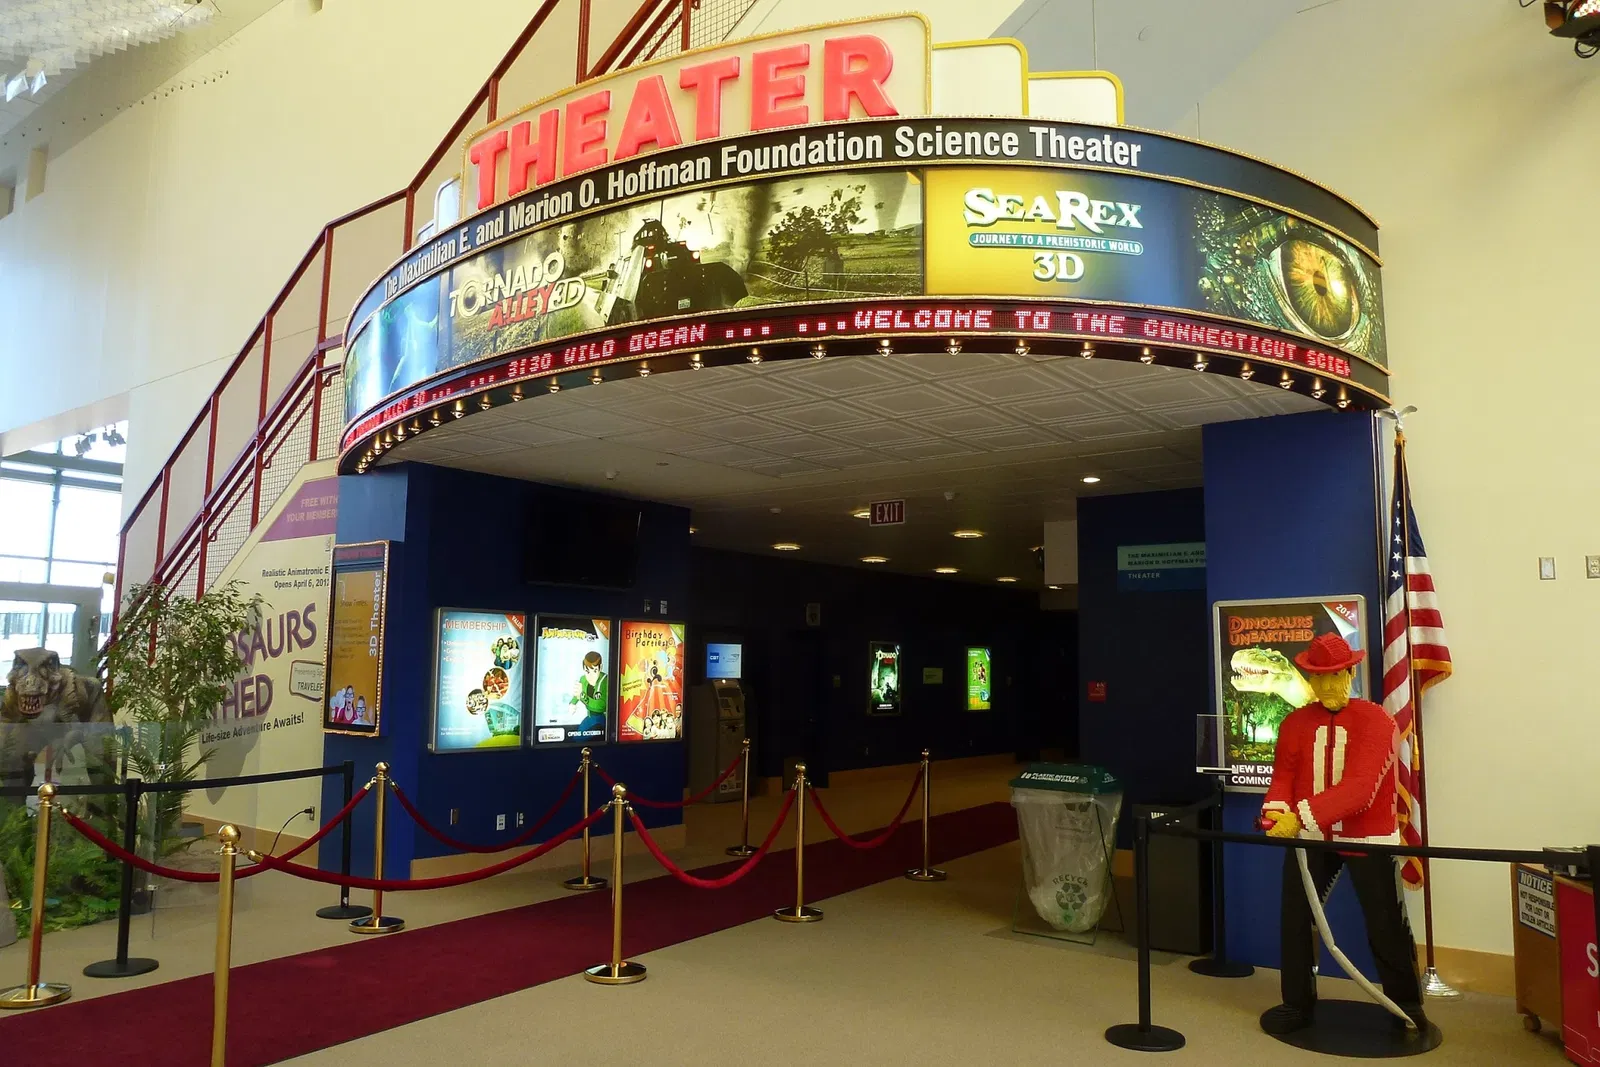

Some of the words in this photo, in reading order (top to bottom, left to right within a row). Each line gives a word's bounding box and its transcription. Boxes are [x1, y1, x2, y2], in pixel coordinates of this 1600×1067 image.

[470, 34, 899, 210] THEATER
[384, 275, 399, 300] The
[400, 238, 457, 290] Maximilian
[475, 210, 505, 246] and
[508, 192, 573, 233] Marion
[579, 178, 600, 208] O.
[607, 156, 711, 201] Hoffman
[721, 130, 883, 179] Foundation
[894, 125, 1020, 159] Science
[1029, 126, 1142, 168] Theater
[972, 233, 1019, 245] JOURNEY
[1022, 235, 1034, 245] TO
[1036, 235, 1044, 246] A
[1045, 235, 1107, 250] PREHISTORIC
[1109, 239, 1141, 254] WORLD
[1033, 251, 1085, 282] 3D
[449, 250, 566, 319] TORNADO
[487, 282, 557, 331] ALLEY
[550, 278, 586, 310] 3D
[564, 339, 616, 366] WILD
[629, 324, 707, 353] OCEAN
[1013, 310, 1051, 330] TO
[1072, 312, 1126, 334] THE
[1143, 318, 1298, 361] CONNECTICUT
[300, 497, 319, 508] FREE
[286, 511, 305, 522] YOUR
[875, 502, 901, 524] EXIT
[262, 568, 286, 578] Realistic
[287, 566, 323, 577] Animatronic
[1127, 572, 1161, 580] THEATER
[274, 580, 292, 590] Opens
[293, 579, 307, 590] April
[370, 571, 381, 631] Theater
[1335, 603, 1356, 622] 2012
[445, 619, 508, 632] MEMBERSHIP
[625, 628, 663, 640] Birthday
[1228, 615, 1314, 634] DINOSAURS
[369, 635, 378, 657] 3D
[1229, 628, 1315, 647] UNEARTHED
[201, 728, 231, 744] Life-size
[232, 720, 271, 738] Adventure
[273, 711, 305, 730] Awaits!
[1231, 764, 1255, 775] NEW
[1231, 775, 1273, 786] COMING
[1520, 872, 1553, 895] NOTICE
